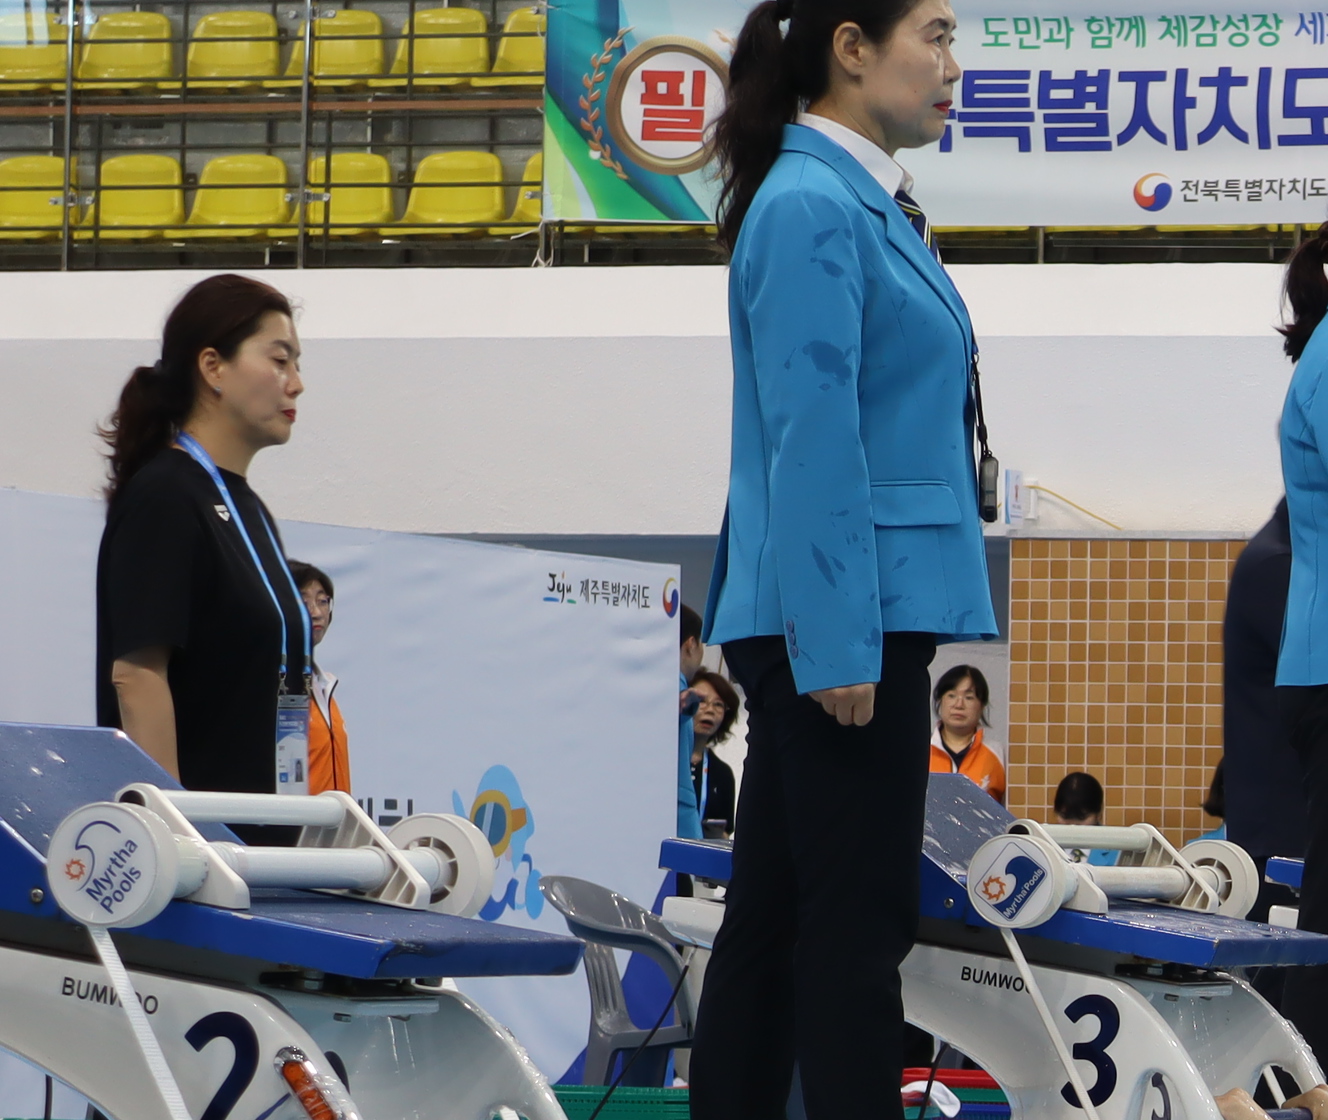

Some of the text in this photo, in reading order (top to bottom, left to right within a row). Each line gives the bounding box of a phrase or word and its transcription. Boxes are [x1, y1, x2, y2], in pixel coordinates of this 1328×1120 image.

[981, 16, 1075, 50] 도민과
[1084, 15, 1147, 49] 함께
[1157, 12, 1284, 48] 체감성장
[639, 70, 706, 143] 필
[579, 578, 650, 609] 제주특별자치도
[85, 839, 138, 902] Myrtha
[100, 866, 142, 915] Pools
[1003, 868, 1043, 918] Myrtha Pools
[1060, 994, 1121, 1109] 3
